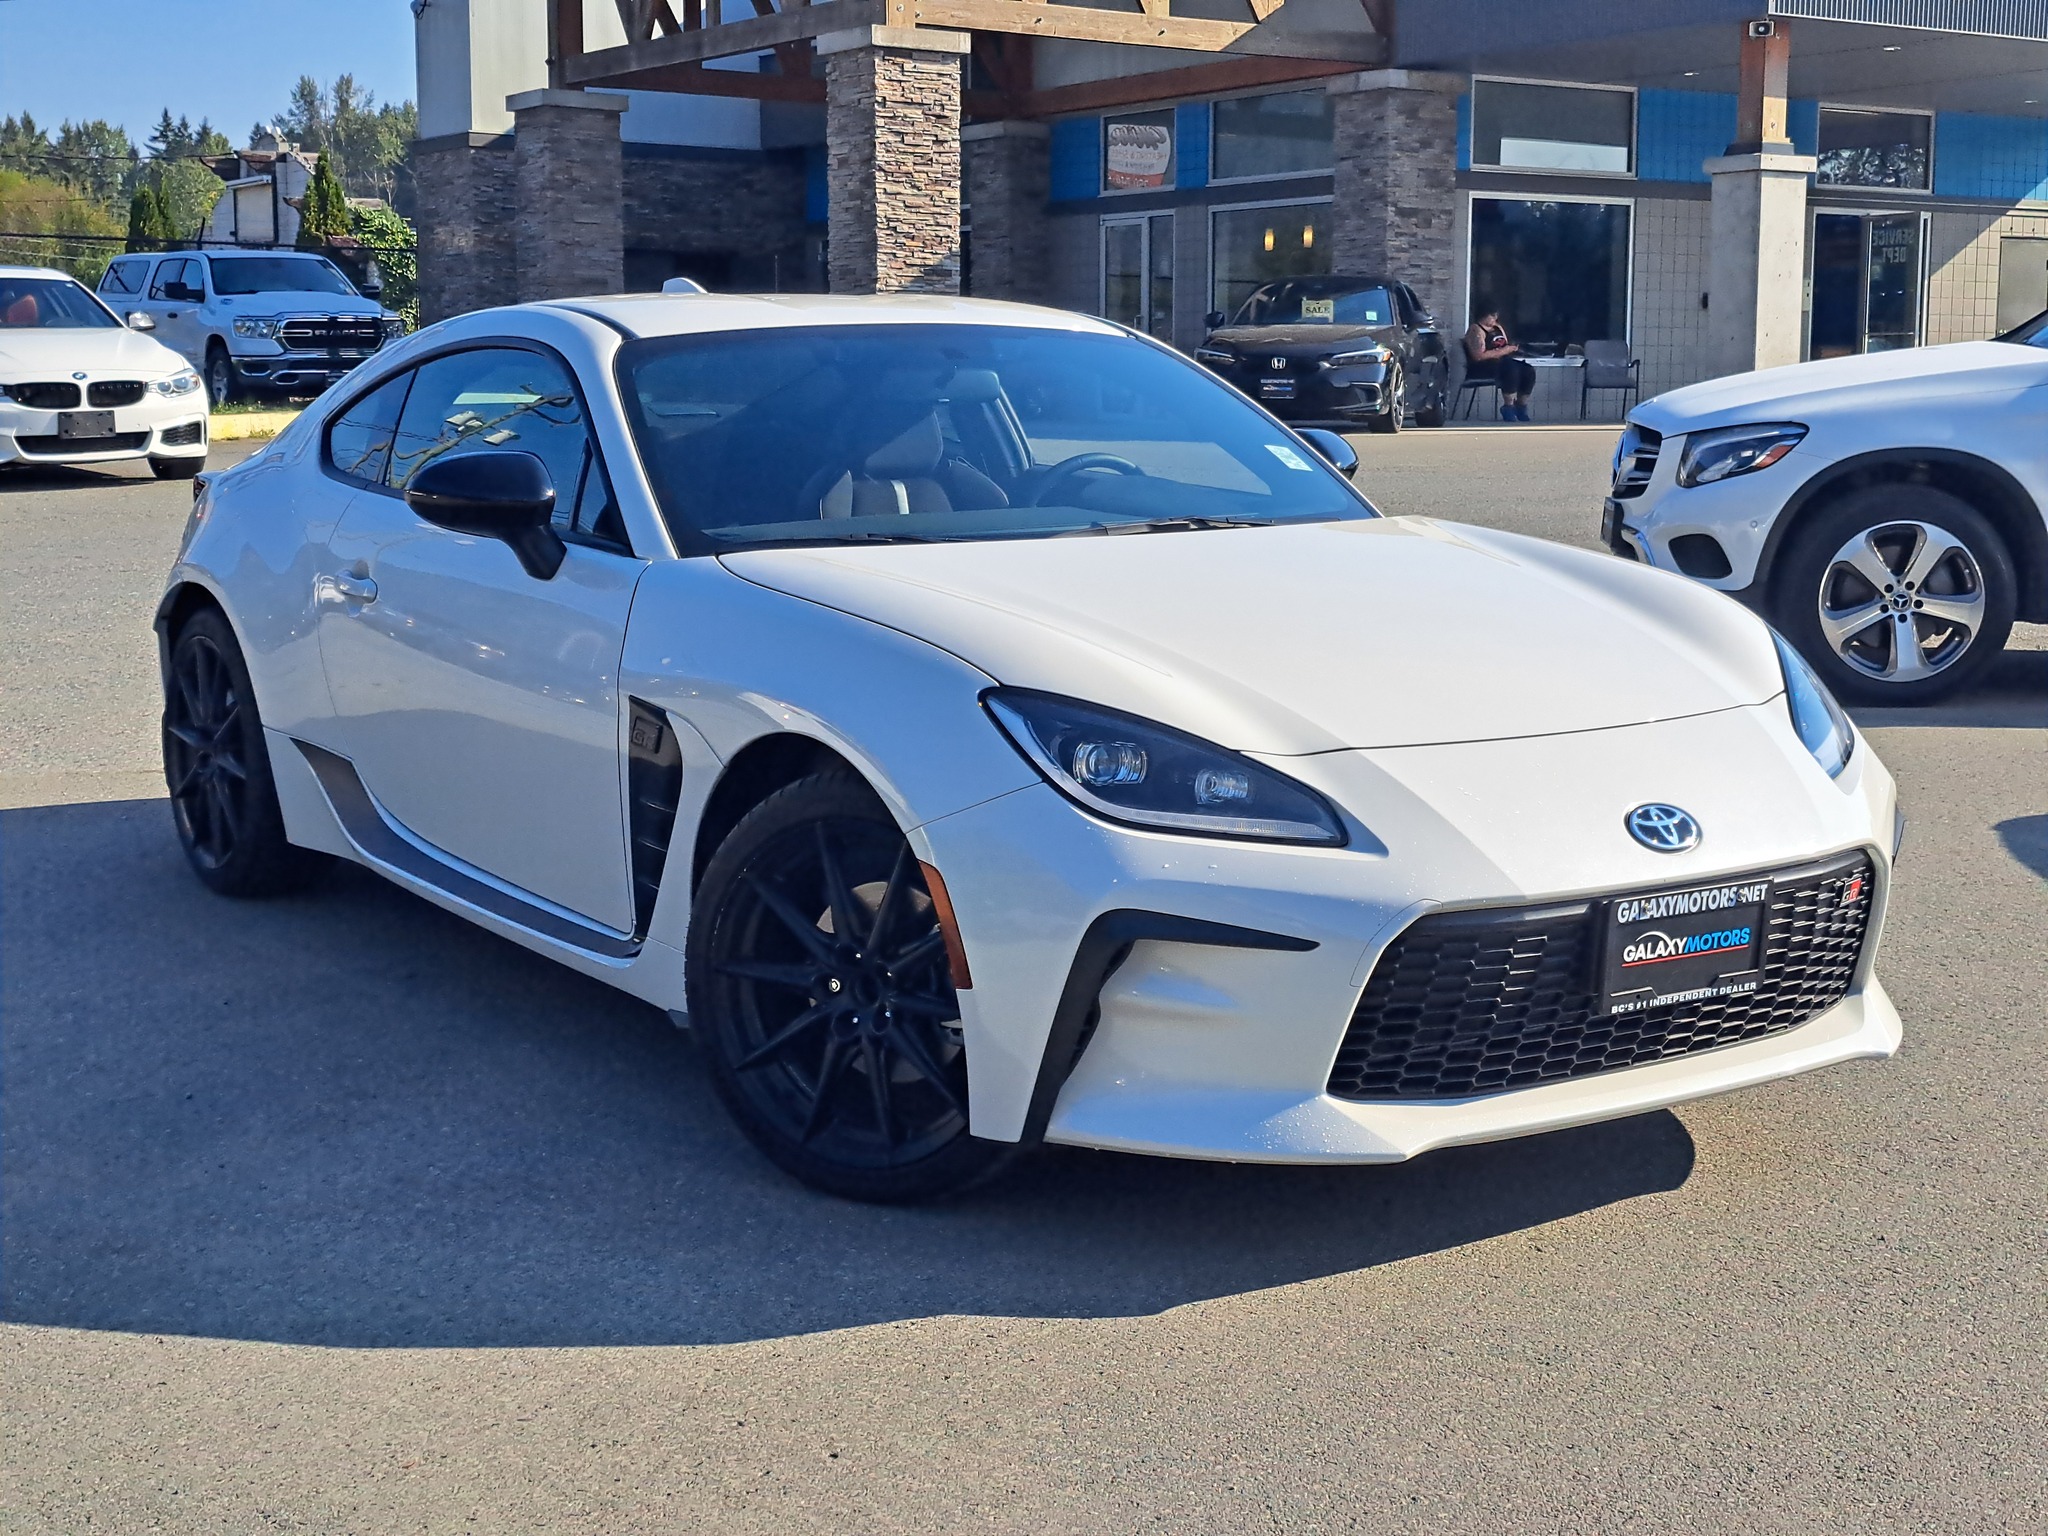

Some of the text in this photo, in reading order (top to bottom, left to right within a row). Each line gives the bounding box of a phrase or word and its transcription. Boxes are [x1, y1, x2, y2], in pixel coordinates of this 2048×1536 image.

[1305, 306, 1330, 314] SALE
[1617, 884, 1768, 924] GALAXYMOTORSNET
[1623, 927, 1750, 963] GALAXYMOTORS
[1611, 1002, 1634, 1014] BC'S
[1649, 988, 1717, 1007] INDEPENDENT
[1719, 982, 1757, 995] DEALER
